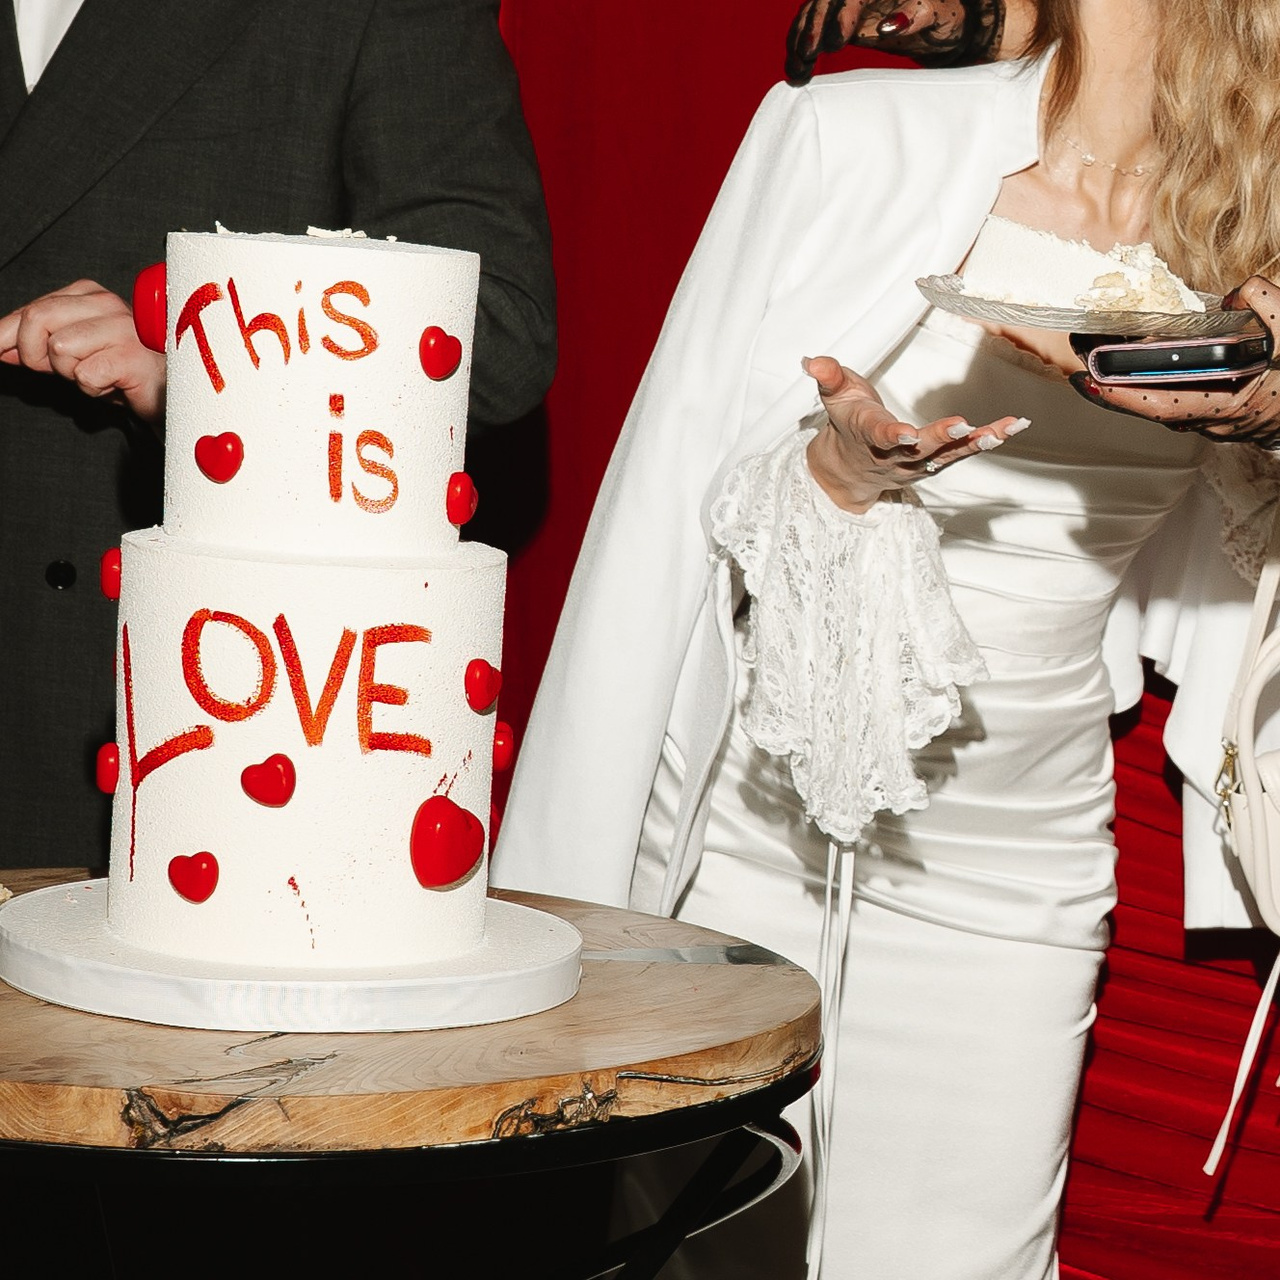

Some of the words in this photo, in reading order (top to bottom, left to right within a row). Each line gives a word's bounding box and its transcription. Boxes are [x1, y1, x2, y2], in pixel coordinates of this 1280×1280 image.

[174, 276, 379, 394] This
[327, 393, 399, 514] is
[122, 607, 433, 798] LOVE
